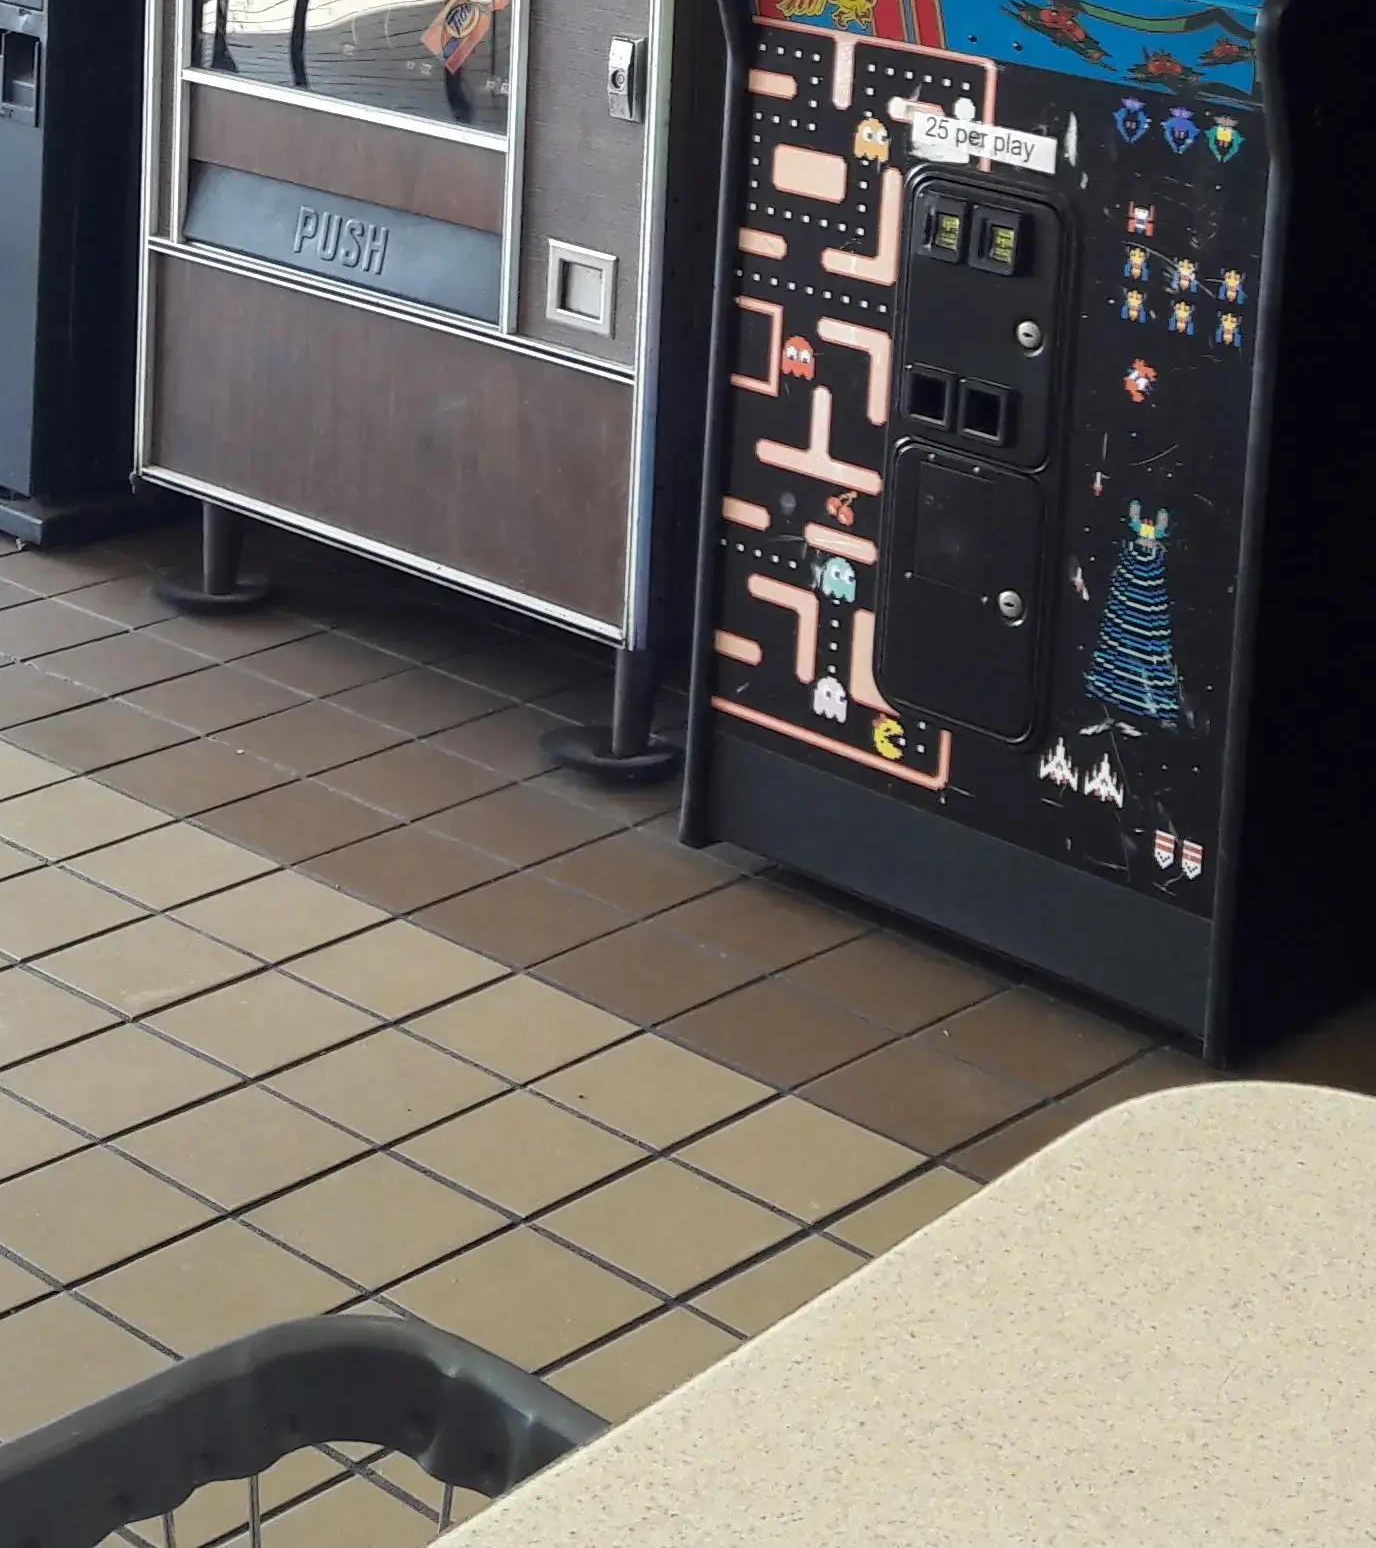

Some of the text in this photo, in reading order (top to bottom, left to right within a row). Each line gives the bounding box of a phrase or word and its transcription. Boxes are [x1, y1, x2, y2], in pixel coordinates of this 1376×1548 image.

[925, 116, 1036, 163] 25 per play
[293, 205, 390, 276] PUSH
